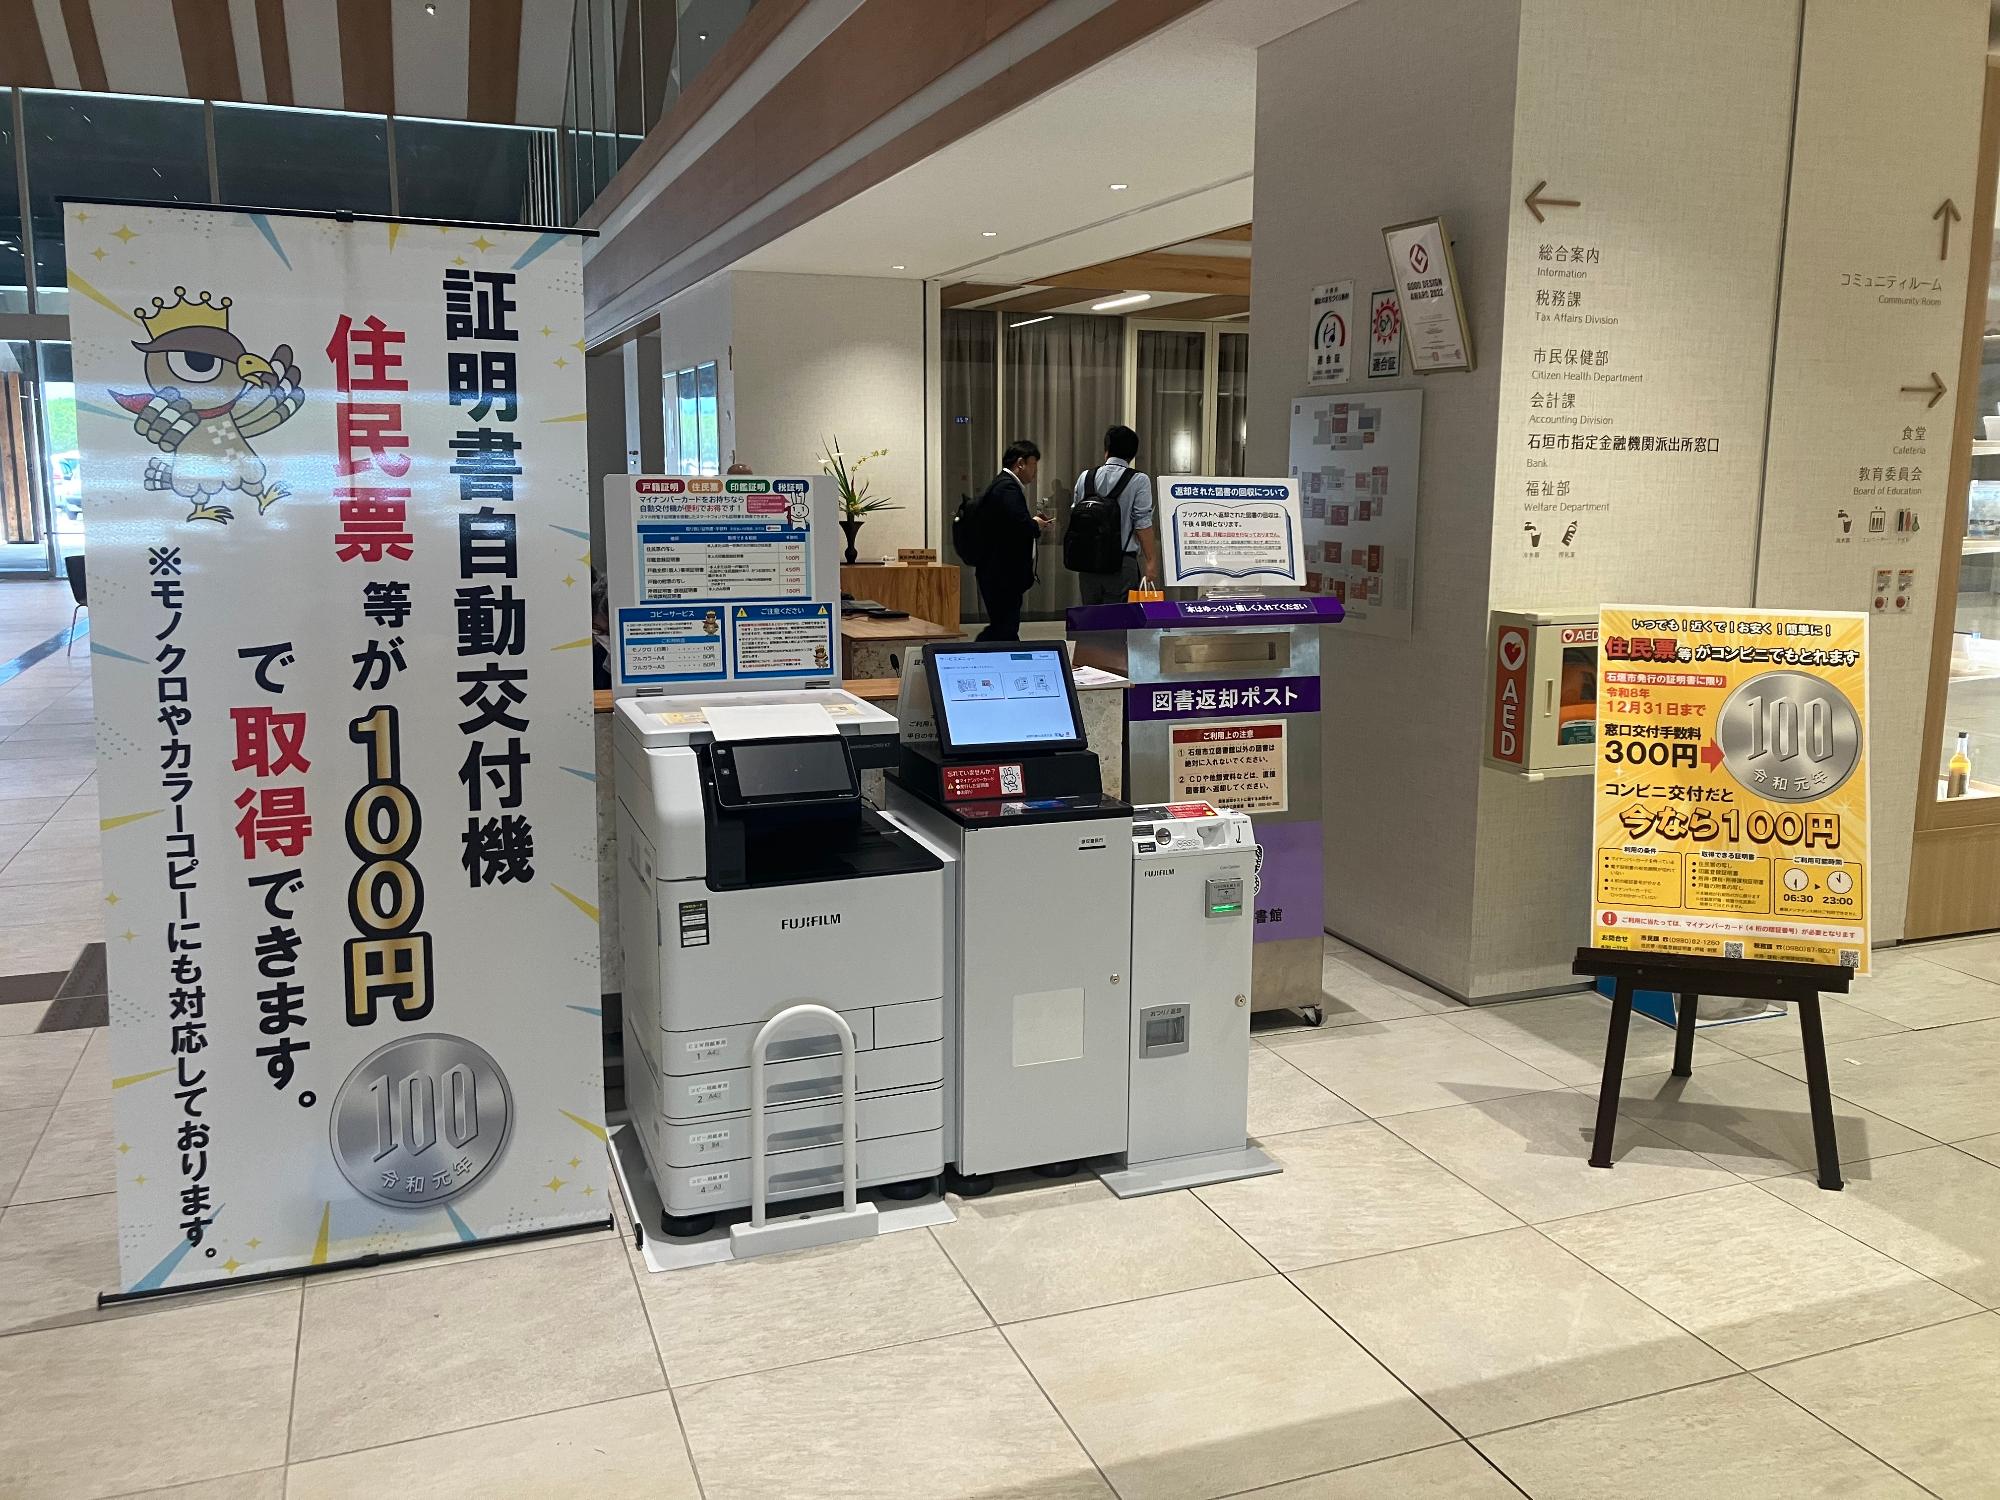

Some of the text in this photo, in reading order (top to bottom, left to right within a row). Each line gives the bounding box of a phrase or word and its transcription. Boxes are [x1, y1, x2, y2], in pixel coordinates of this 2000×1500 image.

[1538, 244, 1600, 264] 総合案内
[1537, 267, 1587, 279] Information
[1406, 278, 1443, 291] GOOD DESIGN
[1841, 273, 1942, 291] コミュニティルーム
[1430, 288, 1444, 298] 2022
[1535, 289, 1582, 307] 税務課
[1878, 294, 1942, 306] Community Room
[1535, 312, 1619, 325] Tax Affairs Division
[1533, 347, 1609, 366] 市民保健部
[1531, 370, 1643, 383] Citizen Health Department
[1530, 391, 1576, 409] 会計課
[1528, 414, 1613, 426] Accounting Division
[1901, 425, 1927, 441] 食堂
[1527, 433, 1720, 453] 石垣市指定金融機関派出所窓口
[1893, 446, 1926, 455] Cafeteria
[1527, 458, 1548, 468] Bank
[1858, 466, 1923, 482] 教育委員会
[641, 482, 804, 492] 戸籍証明 住民票 印鑑証明 税証明
[1174, 486, 1285, 497] 返却された図書の回収について
[1526, 480, 1571, 497] 福祉部
[1853, 486, 1922, 496] Board of Education
[639, 495, 745, 504] マイナンバーカードをお持ちなら
[1524, 502, 1610, 513] Welfare Department
[443, 268, 534, 888] 証明書自動交付機
[649, 610, 695, 618] コピーサービス
[760, 607, 805, 615] ご注意ください
[1186, 602, 1308, 614] 本はゆっくりと優しく入れてください
[1632, 618, 1832, 637] いつでも！近くで！お安く！簡単に！
[326, 313, 434, 1027] 住民票等が100円
[1606, 671, 1724, 687] 石垣市発行の証明書に限り
[1152, 685, 1299, 712] 図書返却ポスト
[1606, 686, 1650, 699] 令和8年
[1606, 699, 1706, 717] 12月31日まで
[1500, 678, 1519, 756] AED
[1203, 729, 1254, 740] ご利用上の注意
[1604, 723, 1702, 740] 窓口交付手数料
[1747, 694, 1834, 764] 100
[1188, 744, 1275, 756] 石垣市立図書館以外の図書は
[1604, 740, 1698, 769] 300円
[1184, 756, 1269, 768] 絶対に入れないでください。
[947, 768, 996, 778] 忘れていませんか？
[1753, 767, 1830, 791] 令和元年
[1604, 782, 1734, 803] コンビニ交付だと
[1619, 802, 1841, 850] 今なら100円
[1624, 846, 1657, 854] 利用の条件
[1701, 851, 1755, 860] 取得できる証明書
[229, 641, 317, 1108] で取得できます。
[1144, 868, 1175, 878] FUJIFILM
[147, 546, 217, 1258] ※モノクロやカラーコピーにも対応しております。
[1783, 893, 1853, 906] 06:30 23:00
[781, 913, 842, 930] FUJIFILM
[1601, 934, 1629, 943] お問合せ
[697, 1095, 703, 1104] 2
[367, 1062, 480, 1164] 100
[699, 1143, 705, 1152] 3
[380, 1156, 474, 1194] 令和元年
